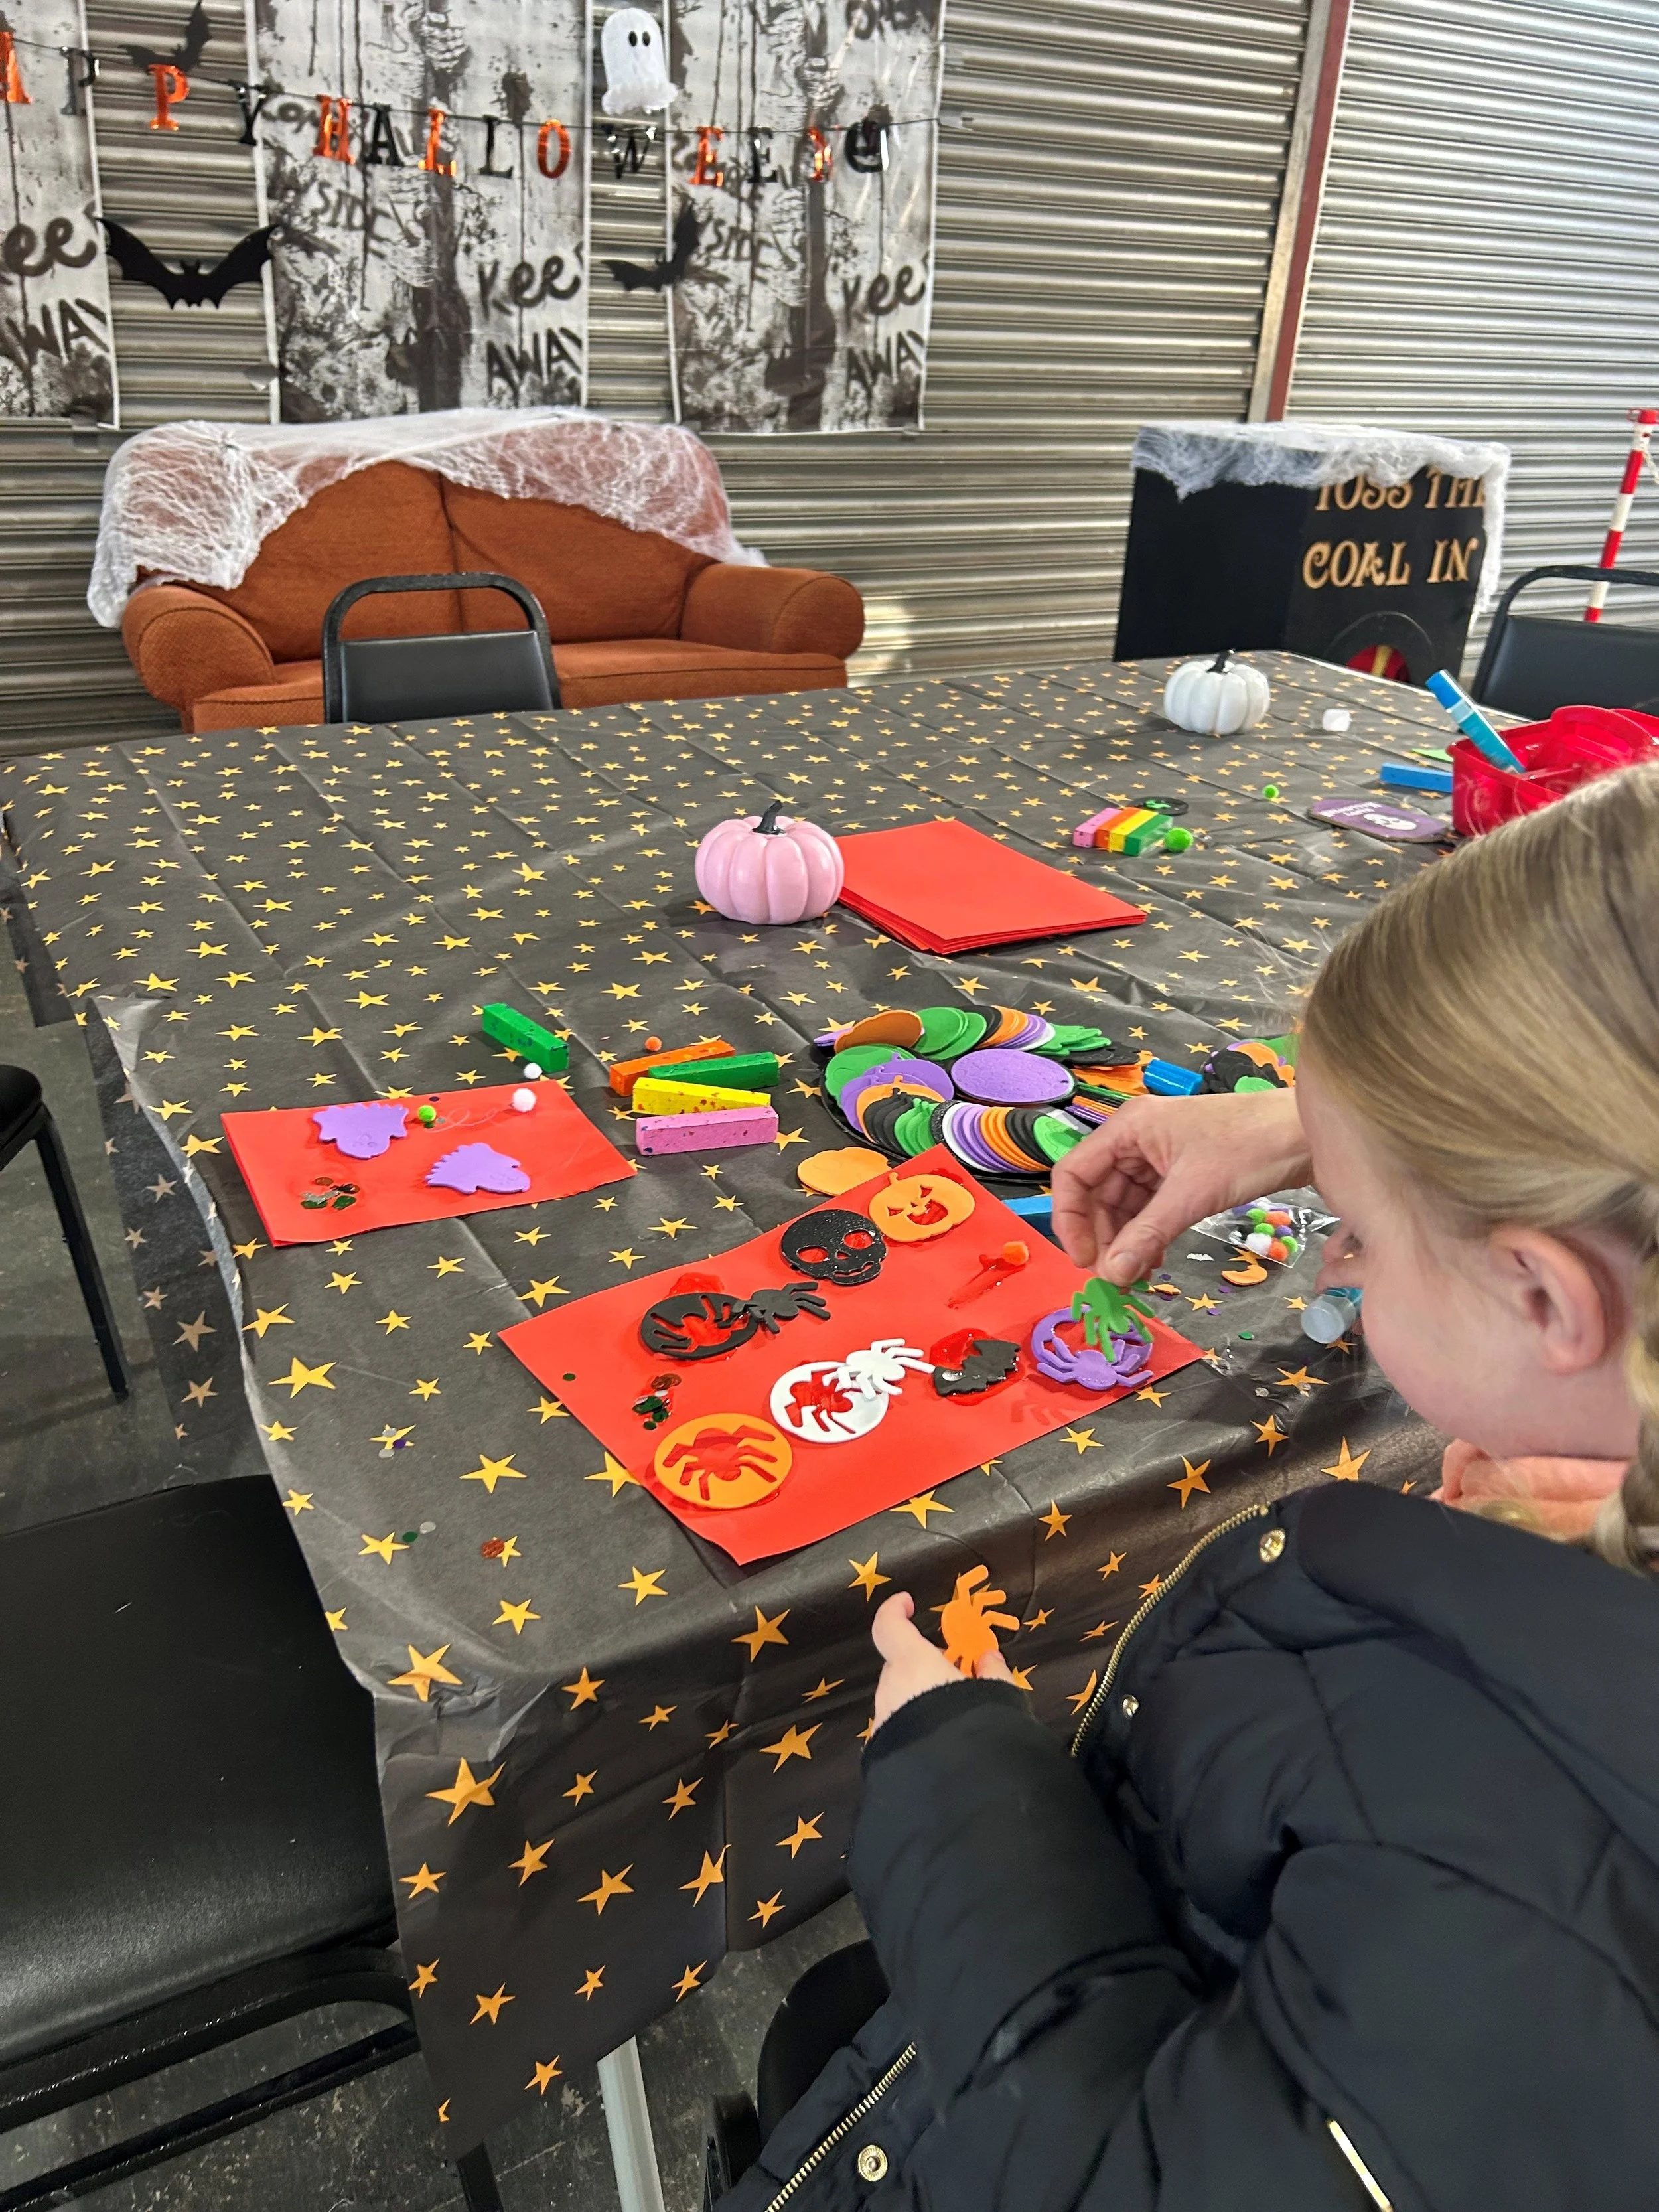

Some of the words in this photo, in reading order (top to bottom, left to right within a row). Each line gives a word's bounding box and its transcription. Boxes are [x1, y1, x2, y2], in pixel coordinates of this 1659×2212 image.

[476, 241, 583, 321] Kee
[843, 252, 929, 330] Kee
[1302, 540, 1411, 589] COAL
[1427, 536, 1479, 584] IN
